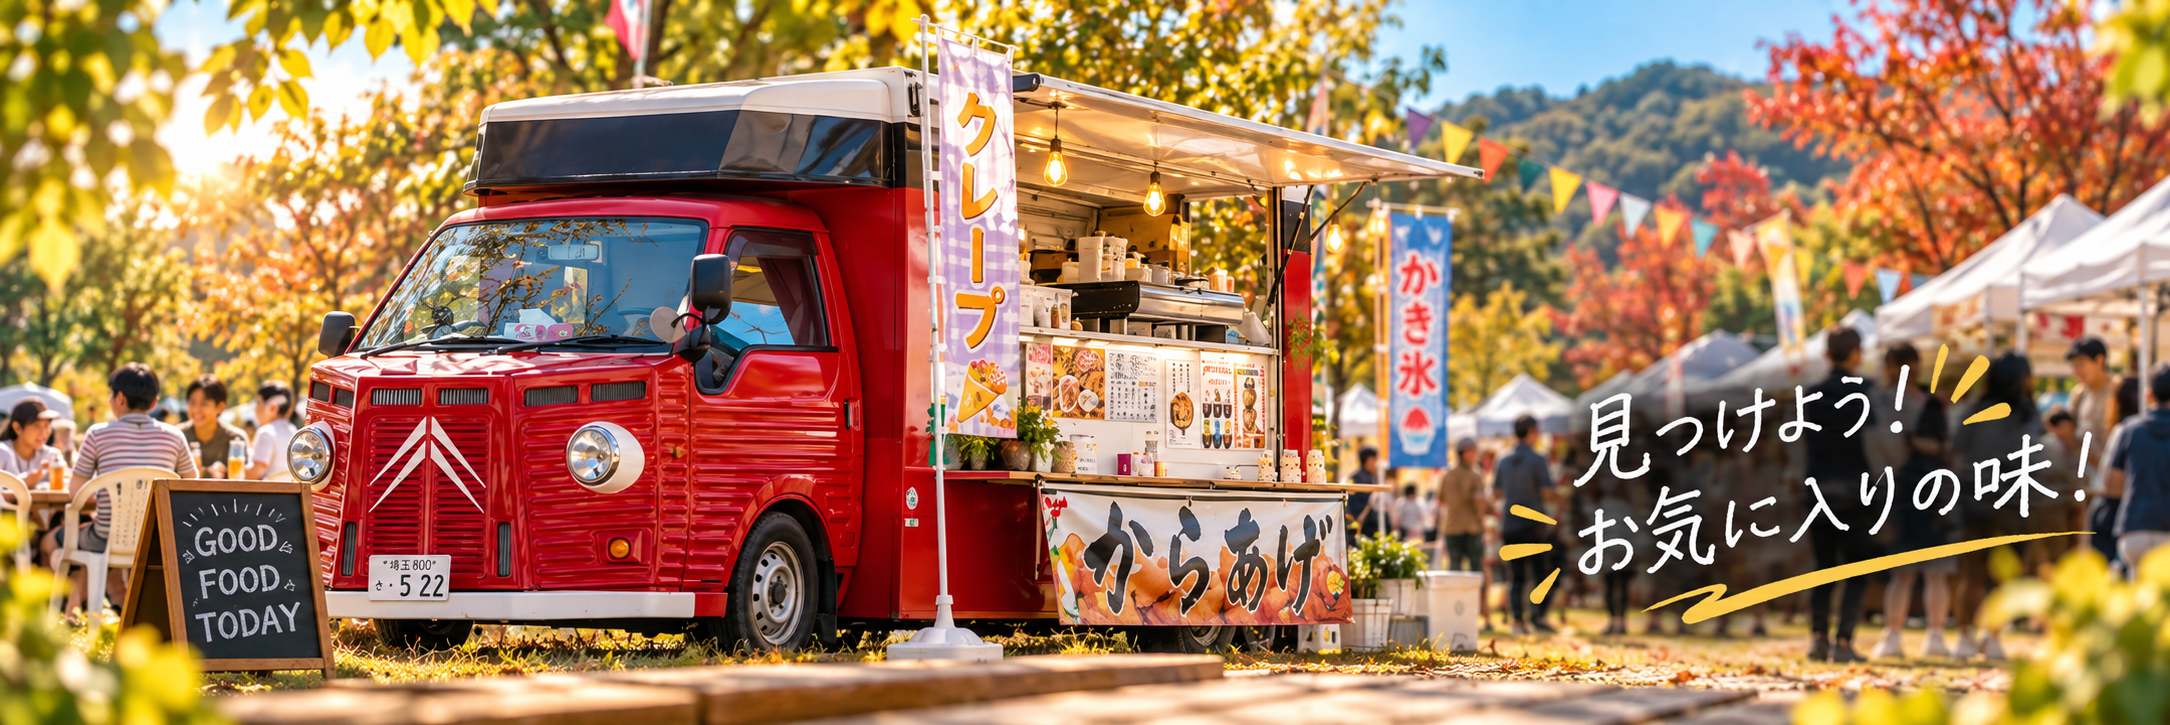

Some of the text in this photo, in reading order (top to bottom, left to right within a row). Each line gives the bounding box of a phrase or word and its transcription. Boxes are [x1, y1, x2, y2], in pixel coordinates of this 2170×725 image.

[954, 91, 1006, 350] クレープ
[1398, 253, 1439, 397] かき氷
[194, 524, 278, 557] GOOD
[1083, 500, 1333, 616] からあげ
[198, 564, 280, 599] FOOD
[412, 559, 432, 571] 800
[195, 601, 301, 643] TODAY
